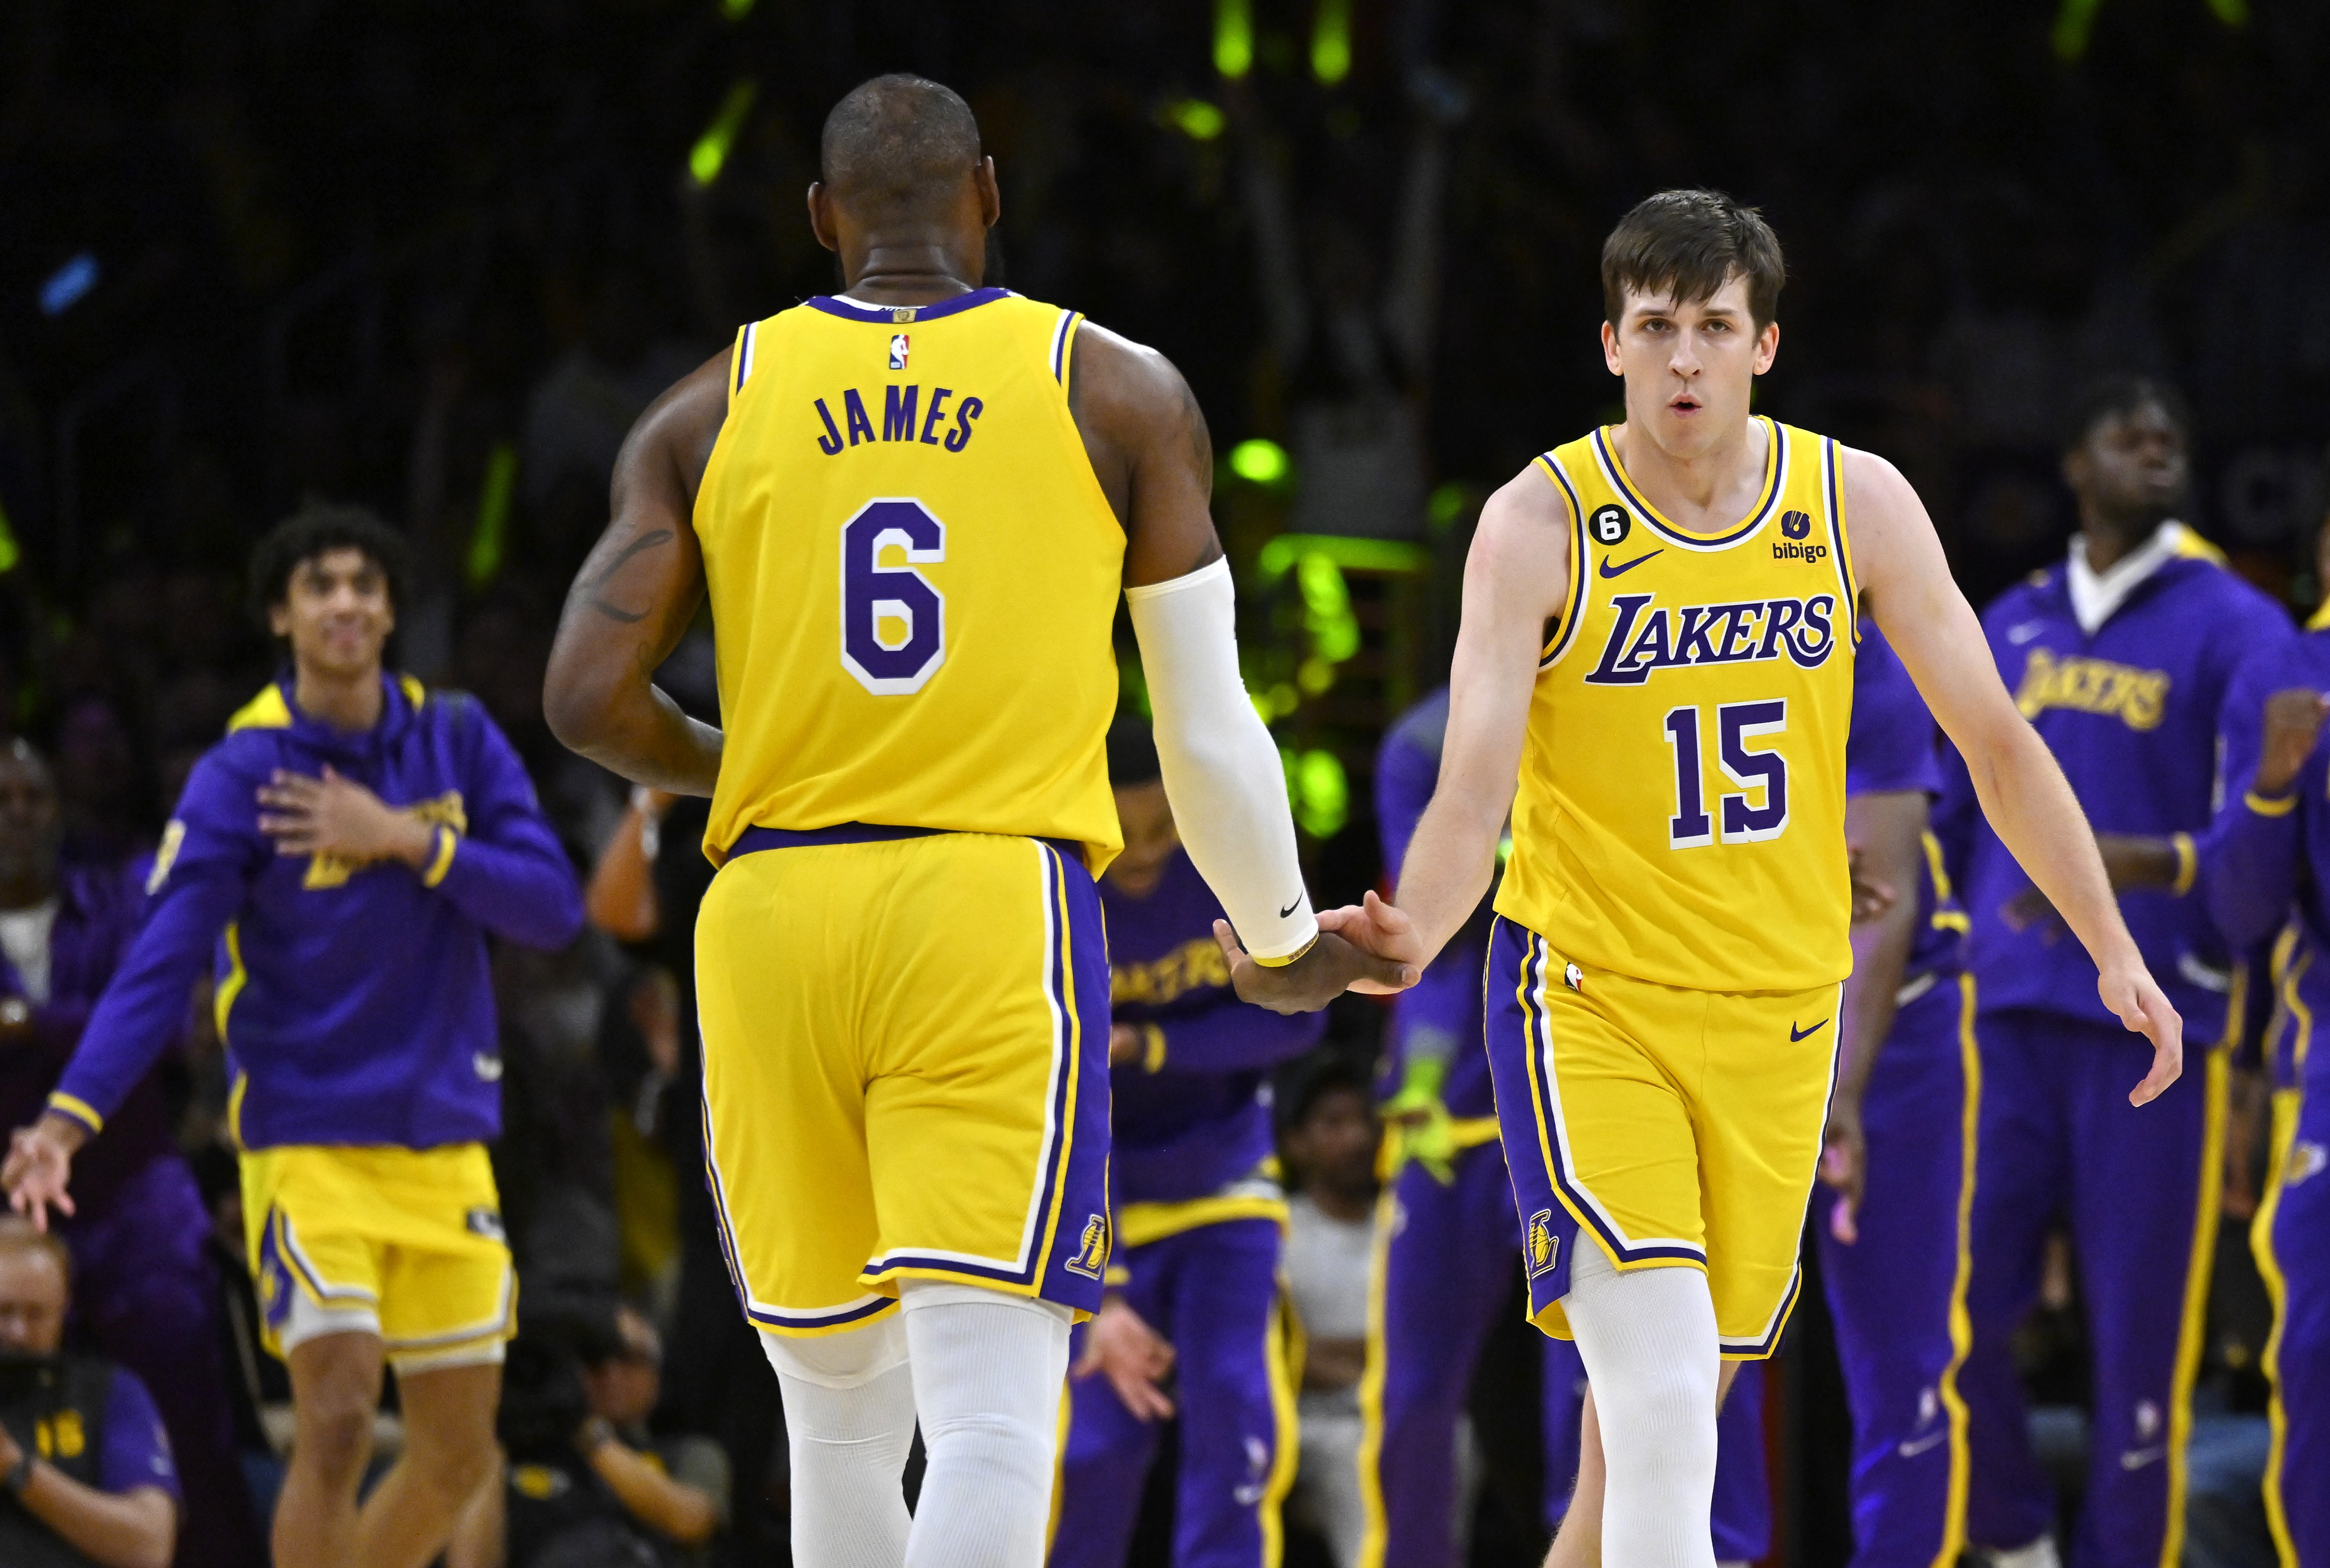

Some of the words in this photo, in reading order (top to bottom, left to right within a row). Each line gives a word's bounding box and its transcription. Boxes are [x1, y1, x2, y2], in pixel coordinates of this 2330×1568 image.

[814, 385, 984, 456] JAMES
[1599, 510, 1622, 541] 6
[1772, 542, 1826, 563] bibigo
[840, 497, 946, 696] 6
[1583, 592, 1836, 686] LAKERS
[1663, 697, 1790, 851] 15
